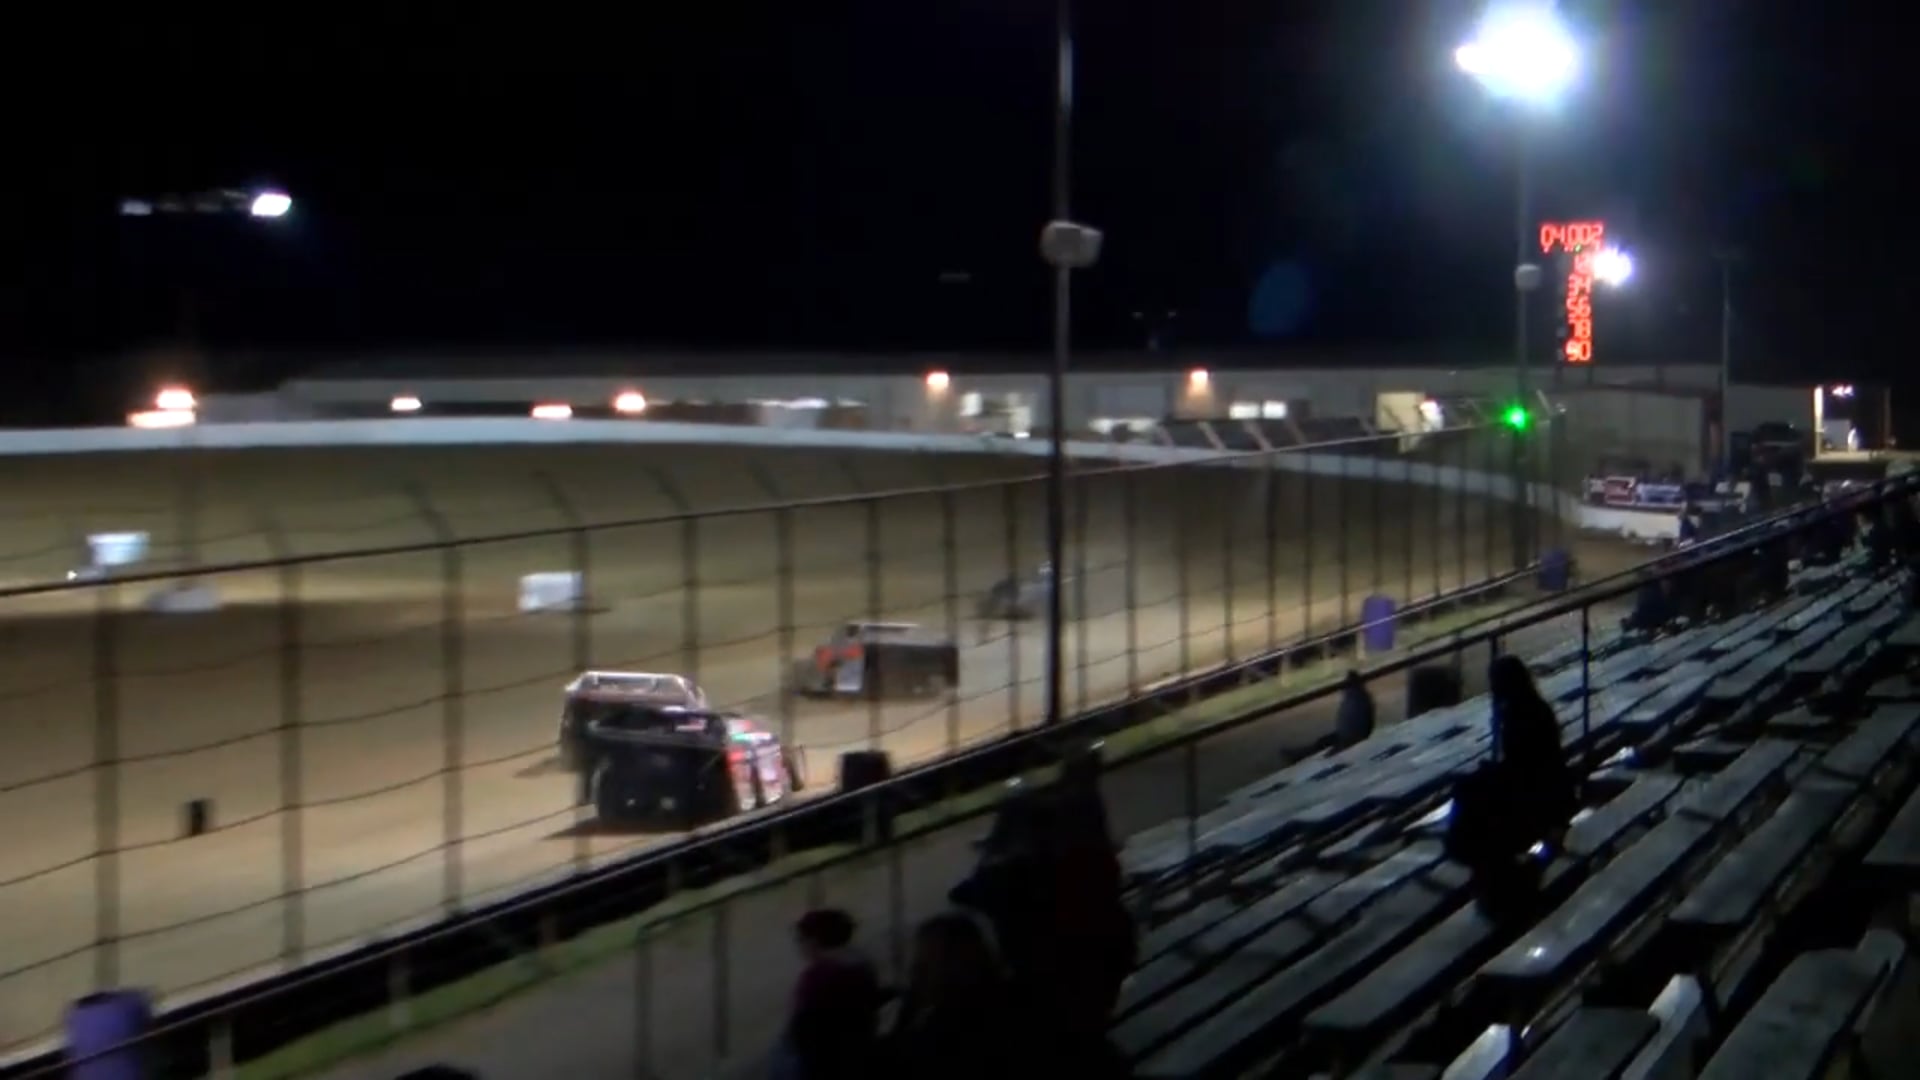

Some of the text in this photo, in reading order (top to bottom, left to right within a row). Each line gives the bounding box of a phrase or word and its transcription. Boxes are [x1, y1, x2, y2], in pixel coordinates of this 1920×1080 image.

[1568, 273, 1592, 296] 34
[1566, 296, 1592, 318] 56
[1567, 318, 1592, 339] 78
